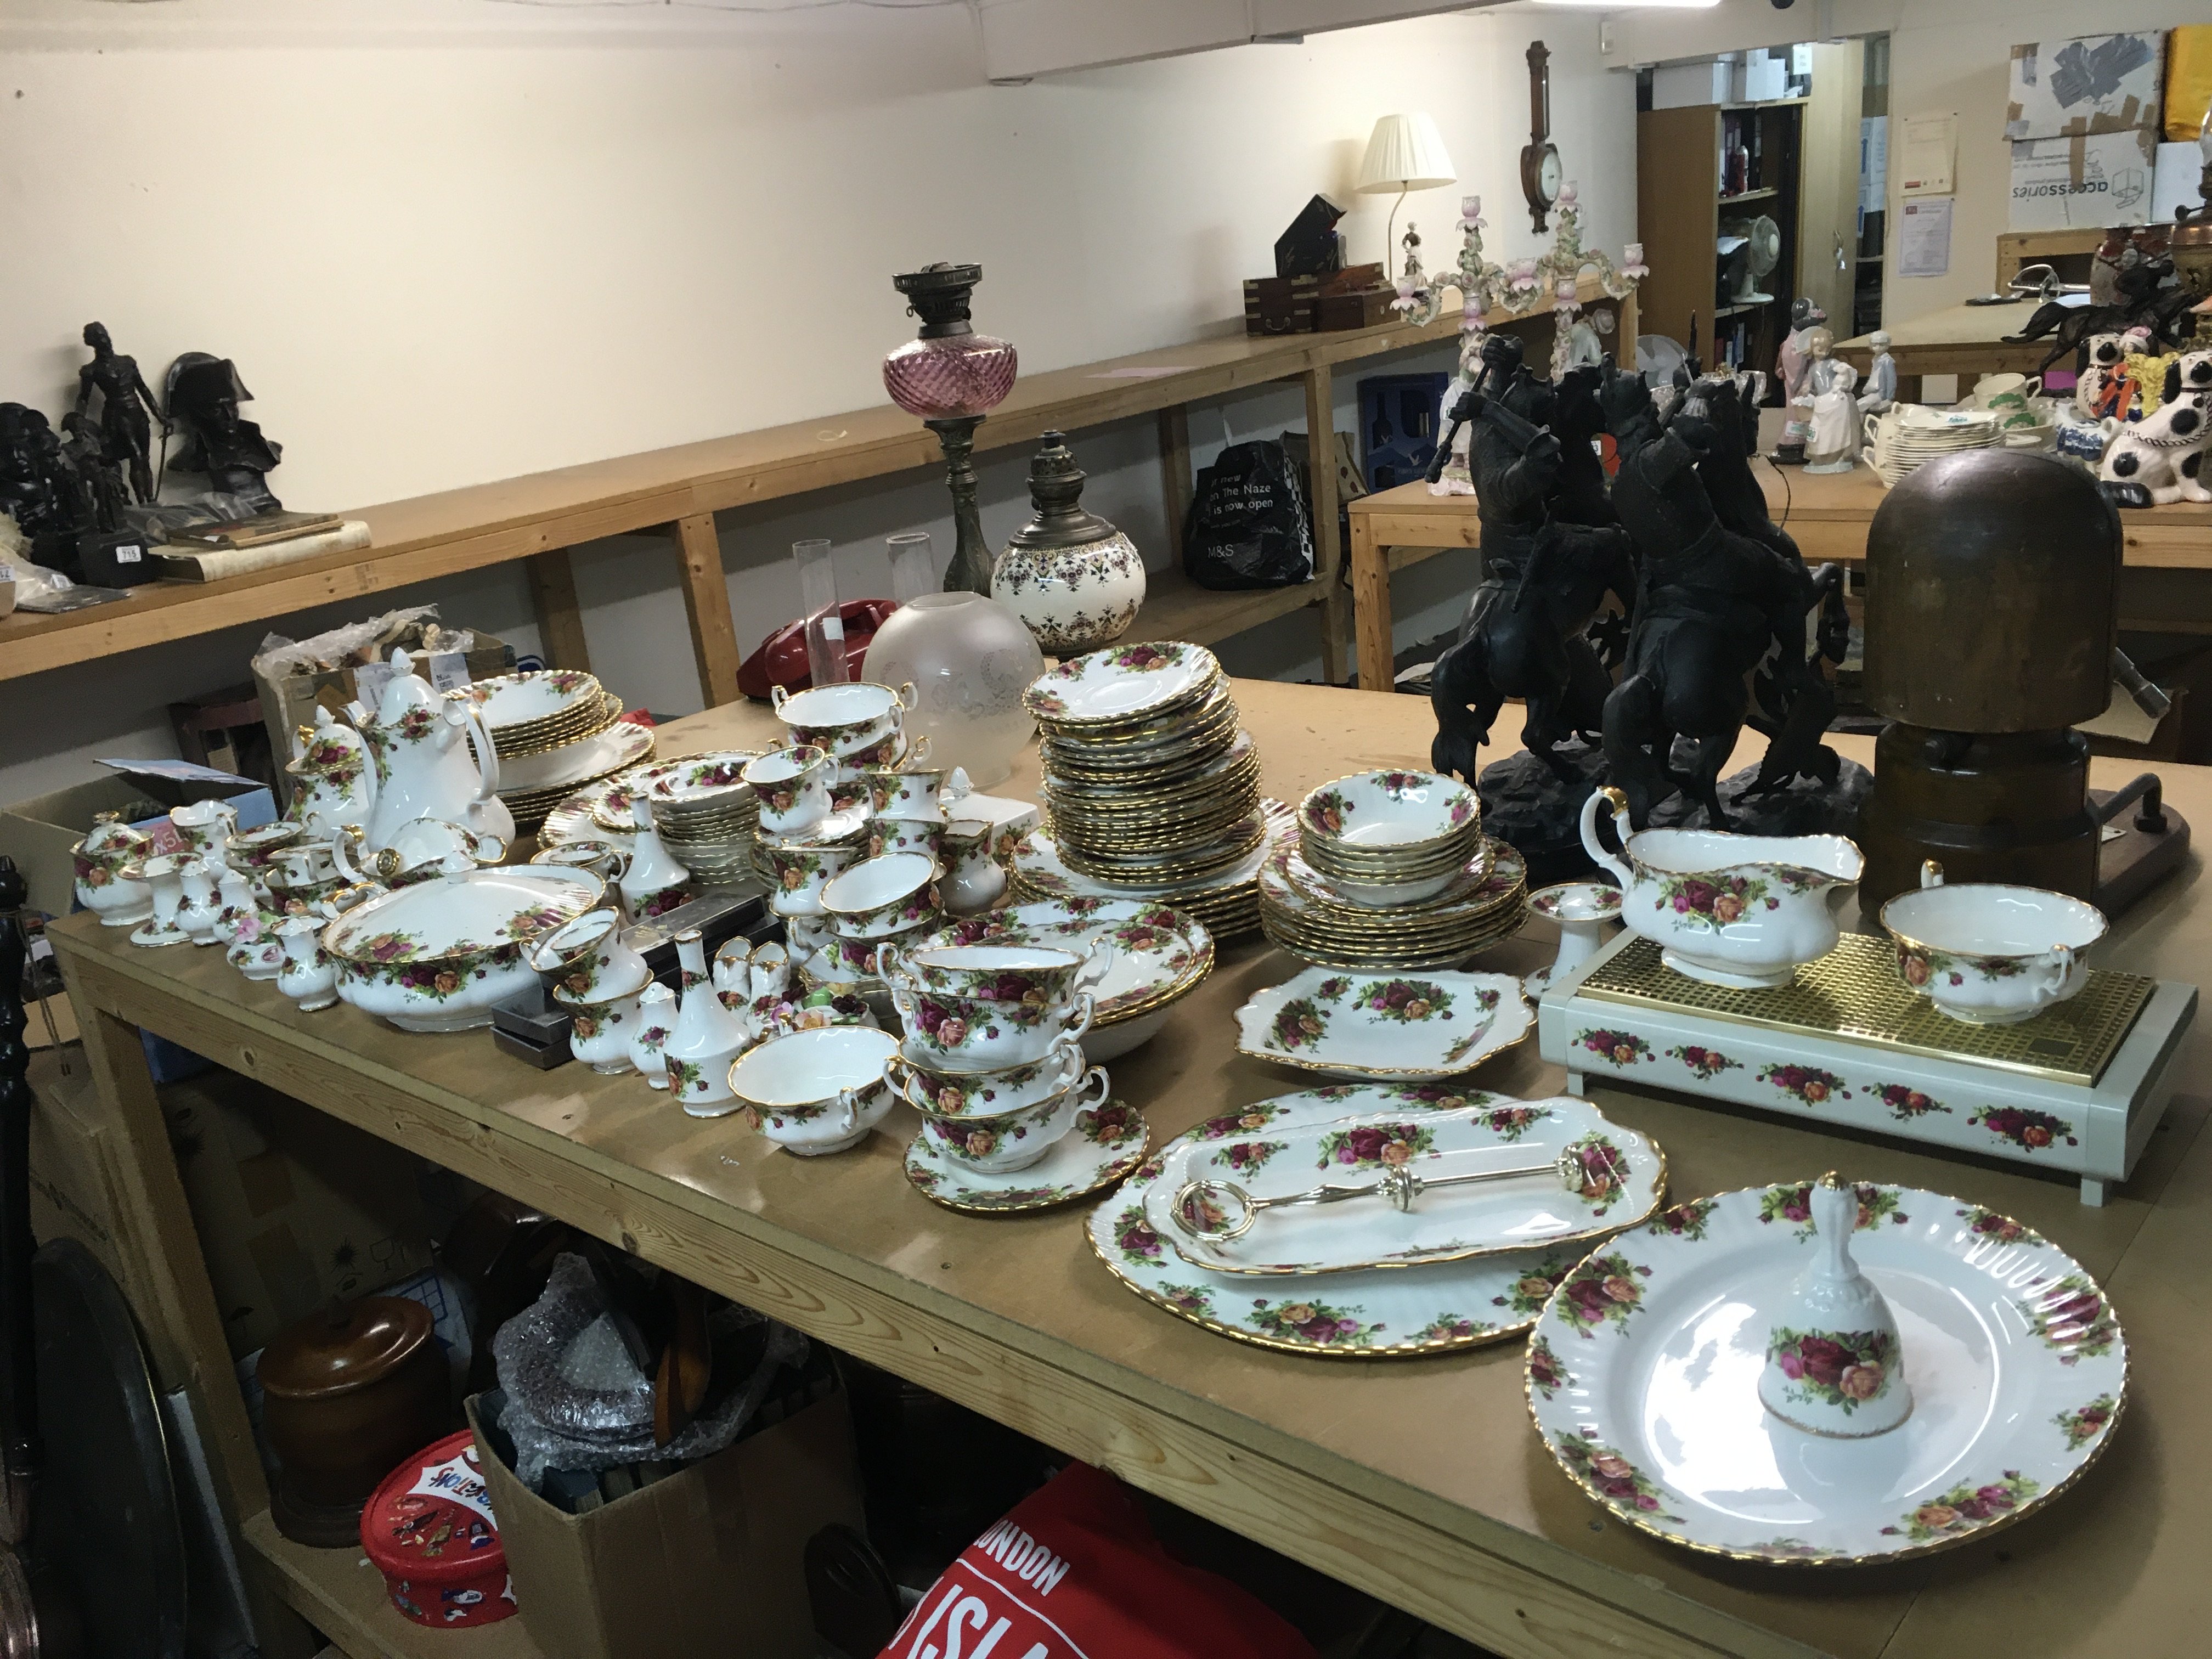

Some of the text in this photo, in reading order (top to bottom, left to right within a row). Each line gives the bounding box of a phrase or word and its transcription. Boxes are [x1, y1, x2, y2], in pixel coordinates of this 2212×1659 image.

[2012, 182, 2108, 202] accessories
[1221, 474, 1241, 483] new
[1222, 487, 1239, 498] The
[1244, 484, 1271, 494] Naze
[1214, 499, 1273, 515] is now open
[122, 550, 137, 559] 715
[1207, 544, 1234, 558] M&S
[0, 569, 11, 578] 71
[973, 1519, 1071, 1596] LONDON
[907, 1584, 1048, 1659] ISL
